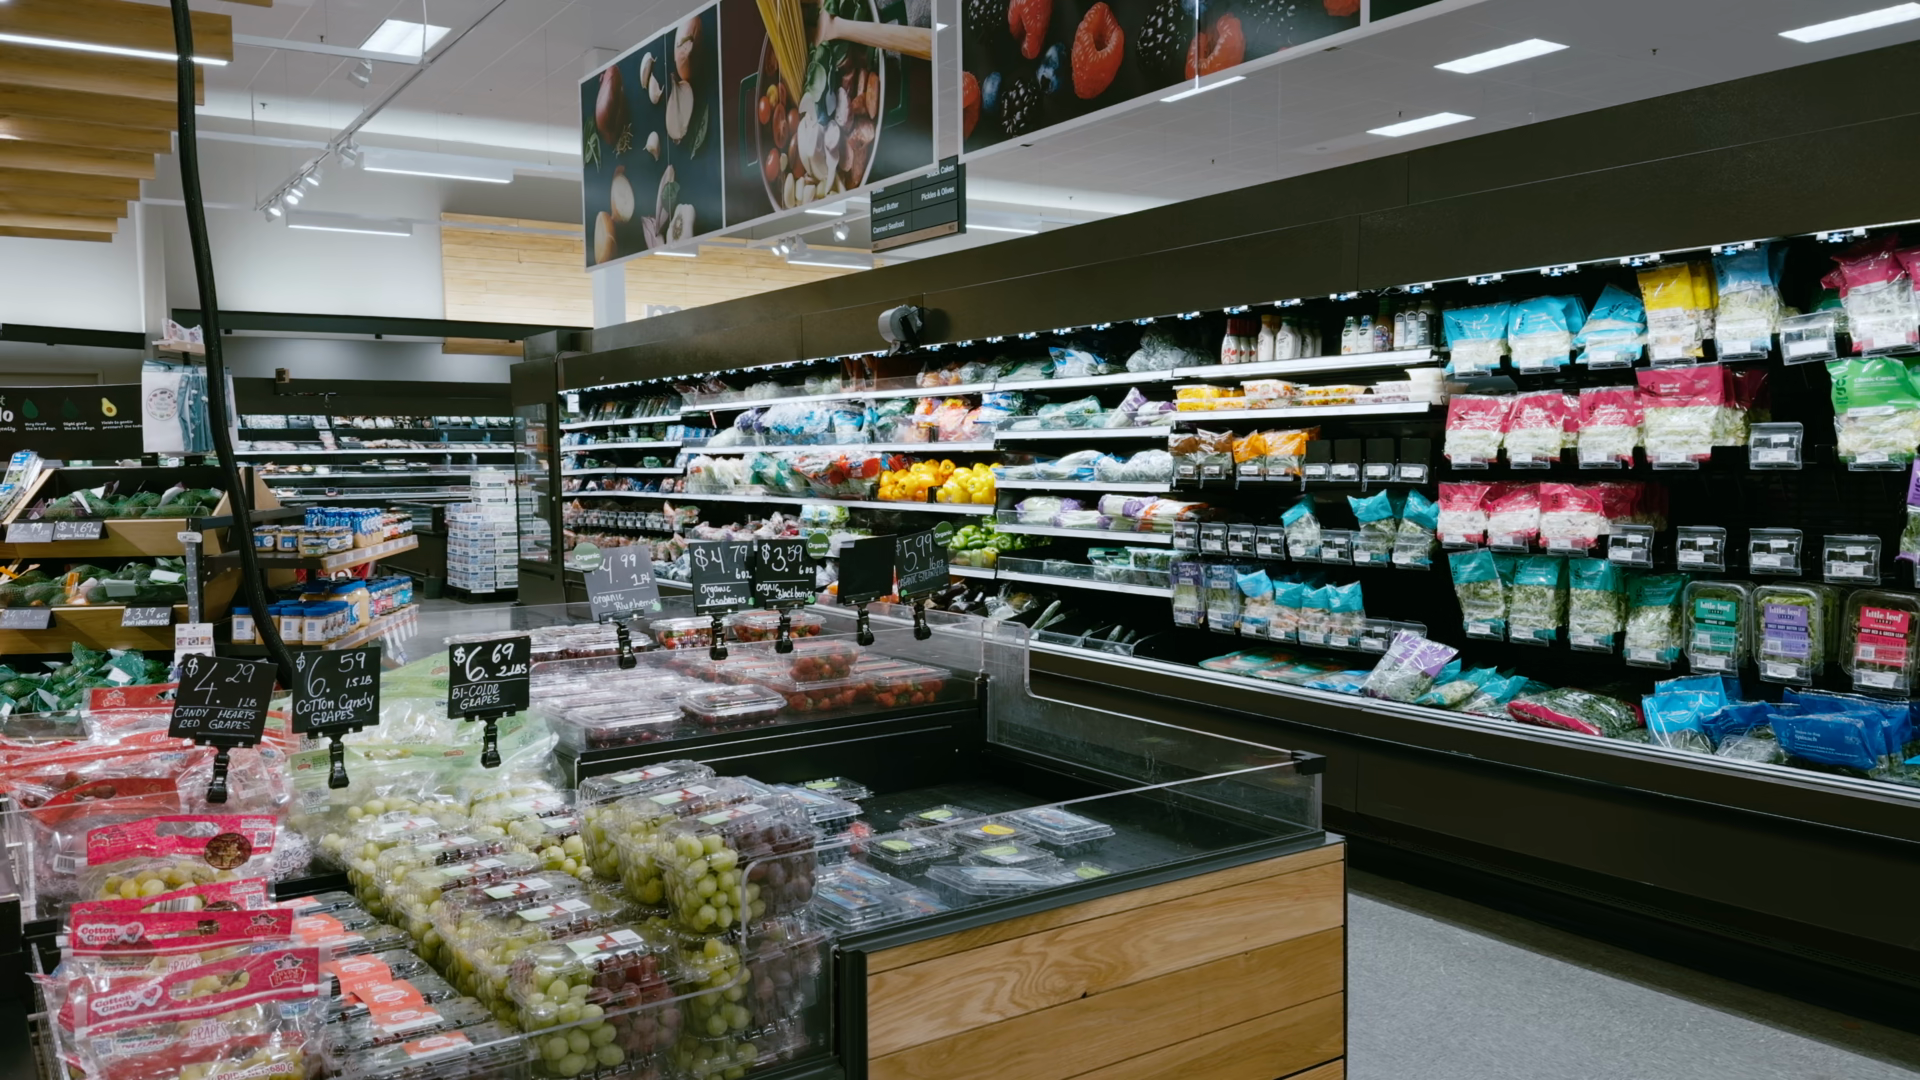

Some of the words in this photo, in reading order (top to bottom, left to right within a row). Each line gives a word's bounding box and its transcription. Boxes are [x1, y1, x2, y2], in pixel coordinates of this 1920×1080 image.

[941, 165, 954, 174] Cakes
[921, 191, 936, 201] Pickles
[941, 186, 955, 195] Olives
[872, 205, 886, 214] Peanut
[887, 201, 899, 211] Butter
[872, 225, 888, 234] Canned
[888, 219, 905, 230] Seafood
[935, 530, 953, 539] Organic
[575, 552, 600, 561] Organic
[694, 545, 748, 574] $4.79
[761, 543, 803, 571] $3.59
[1701, 601, 1716, 609] little
[1717, 603, 1731, 612] leaf
[1770, 606, 1785, 615] little
[1787, 608, 1802, 617] leaf
[1866, 609, 1884, 619] little
[1886, 612, 1904, 623] leaf
[453, 643, 514, 682] $6.69
[185, 657, 256, 705] $4.29
[296, 652, 366, 698] $6.59
[452, 684, 500, 700] BI-COLOR
[338, 692, 374, 712] Candy
[460, 694, 500, 710] GRAPES
[174, 707, 209, 718] CANDY
[217, 709, 255, 720] HEARTS
[311, 710, 354, 726] GRAPES
[178, 719, 200, 728] RED
[208, 719, 251, 730] GRAPES
[80, 926, 116, 935] Cotton
[87, 933, 119, 943] Candy
[94, 993, 132, 1008] Cotton
[101, 999, 137, 1013] Candy
[190, 1023, 228, 1043] GRAPES
